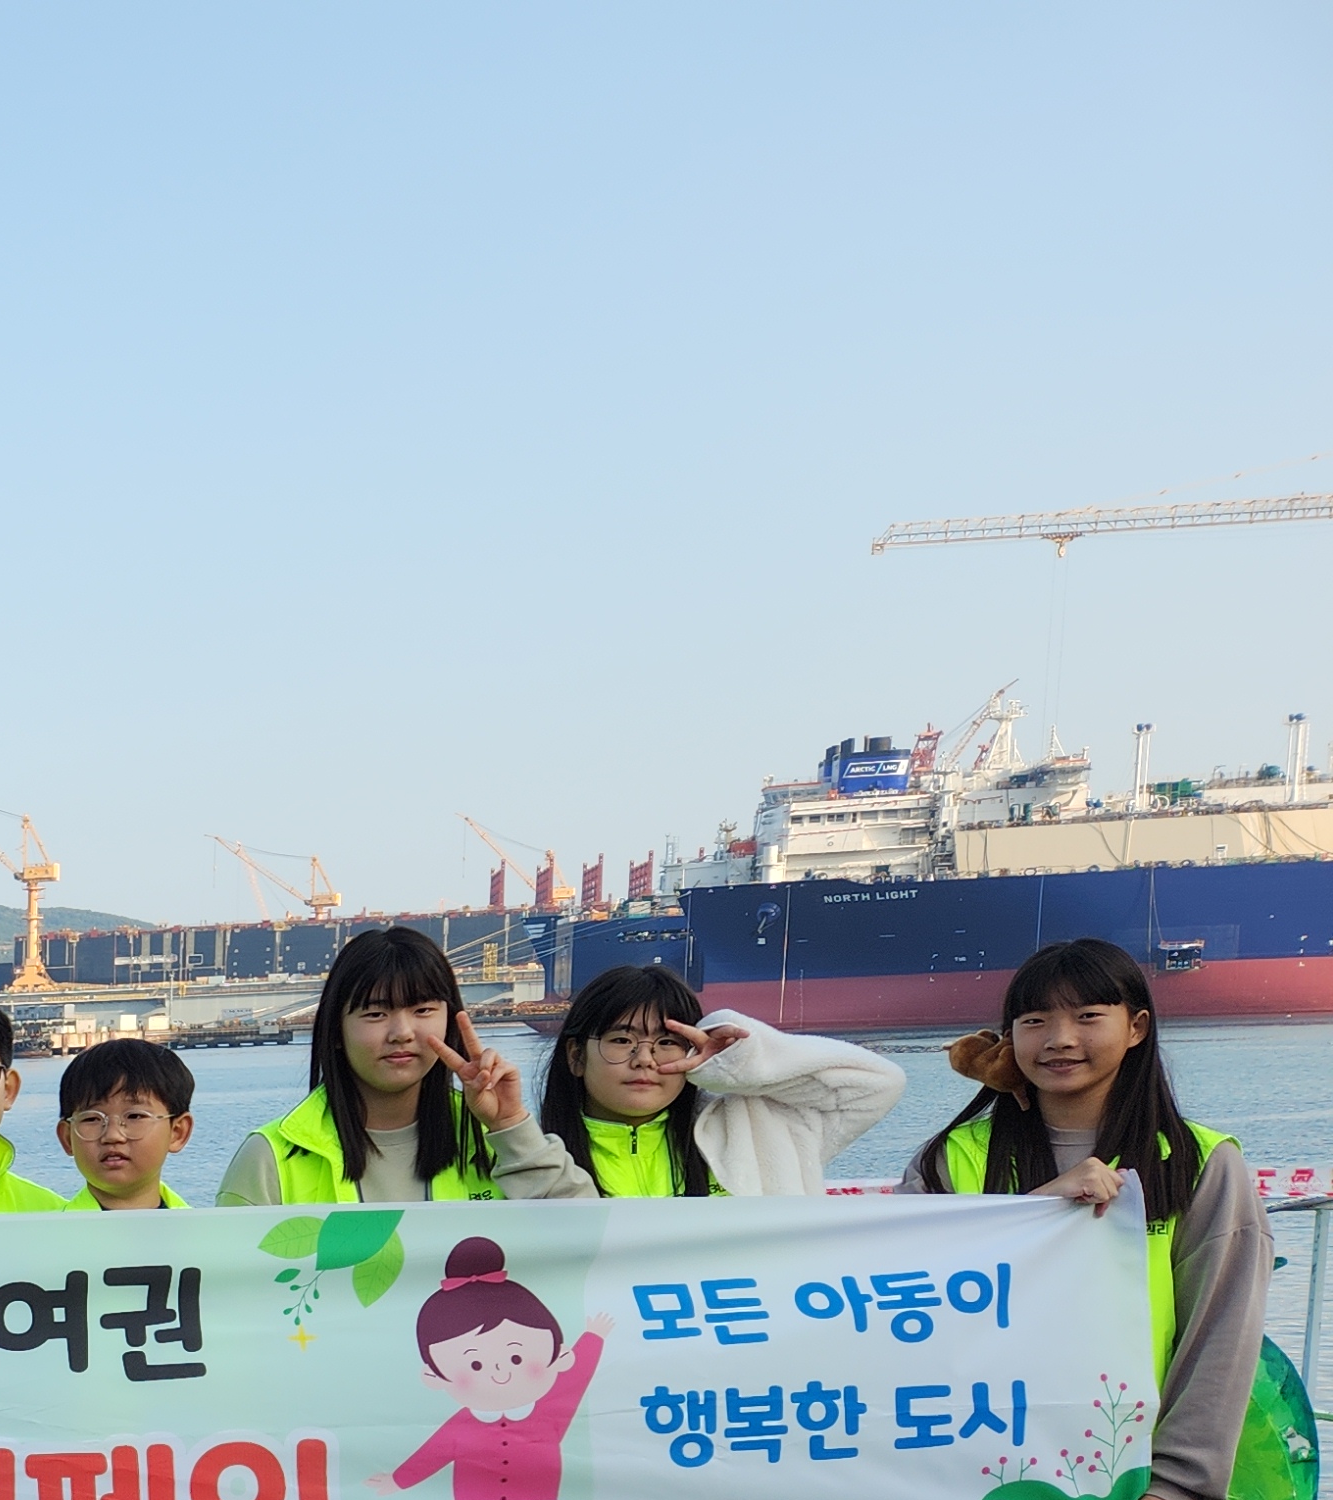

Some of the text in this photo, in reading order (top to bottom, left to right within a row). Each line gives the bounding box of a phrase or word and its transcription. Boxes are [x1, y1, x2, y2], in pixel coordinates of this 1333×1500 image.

[850, 764, 898, 774] ARCTIC LNG
[823, 889, 919, 903] NORTH LIGHT
[633, 1262, 1012, 1345] 모든 아동이
[639, 1379, 1028, 1468] 행복한 도시
